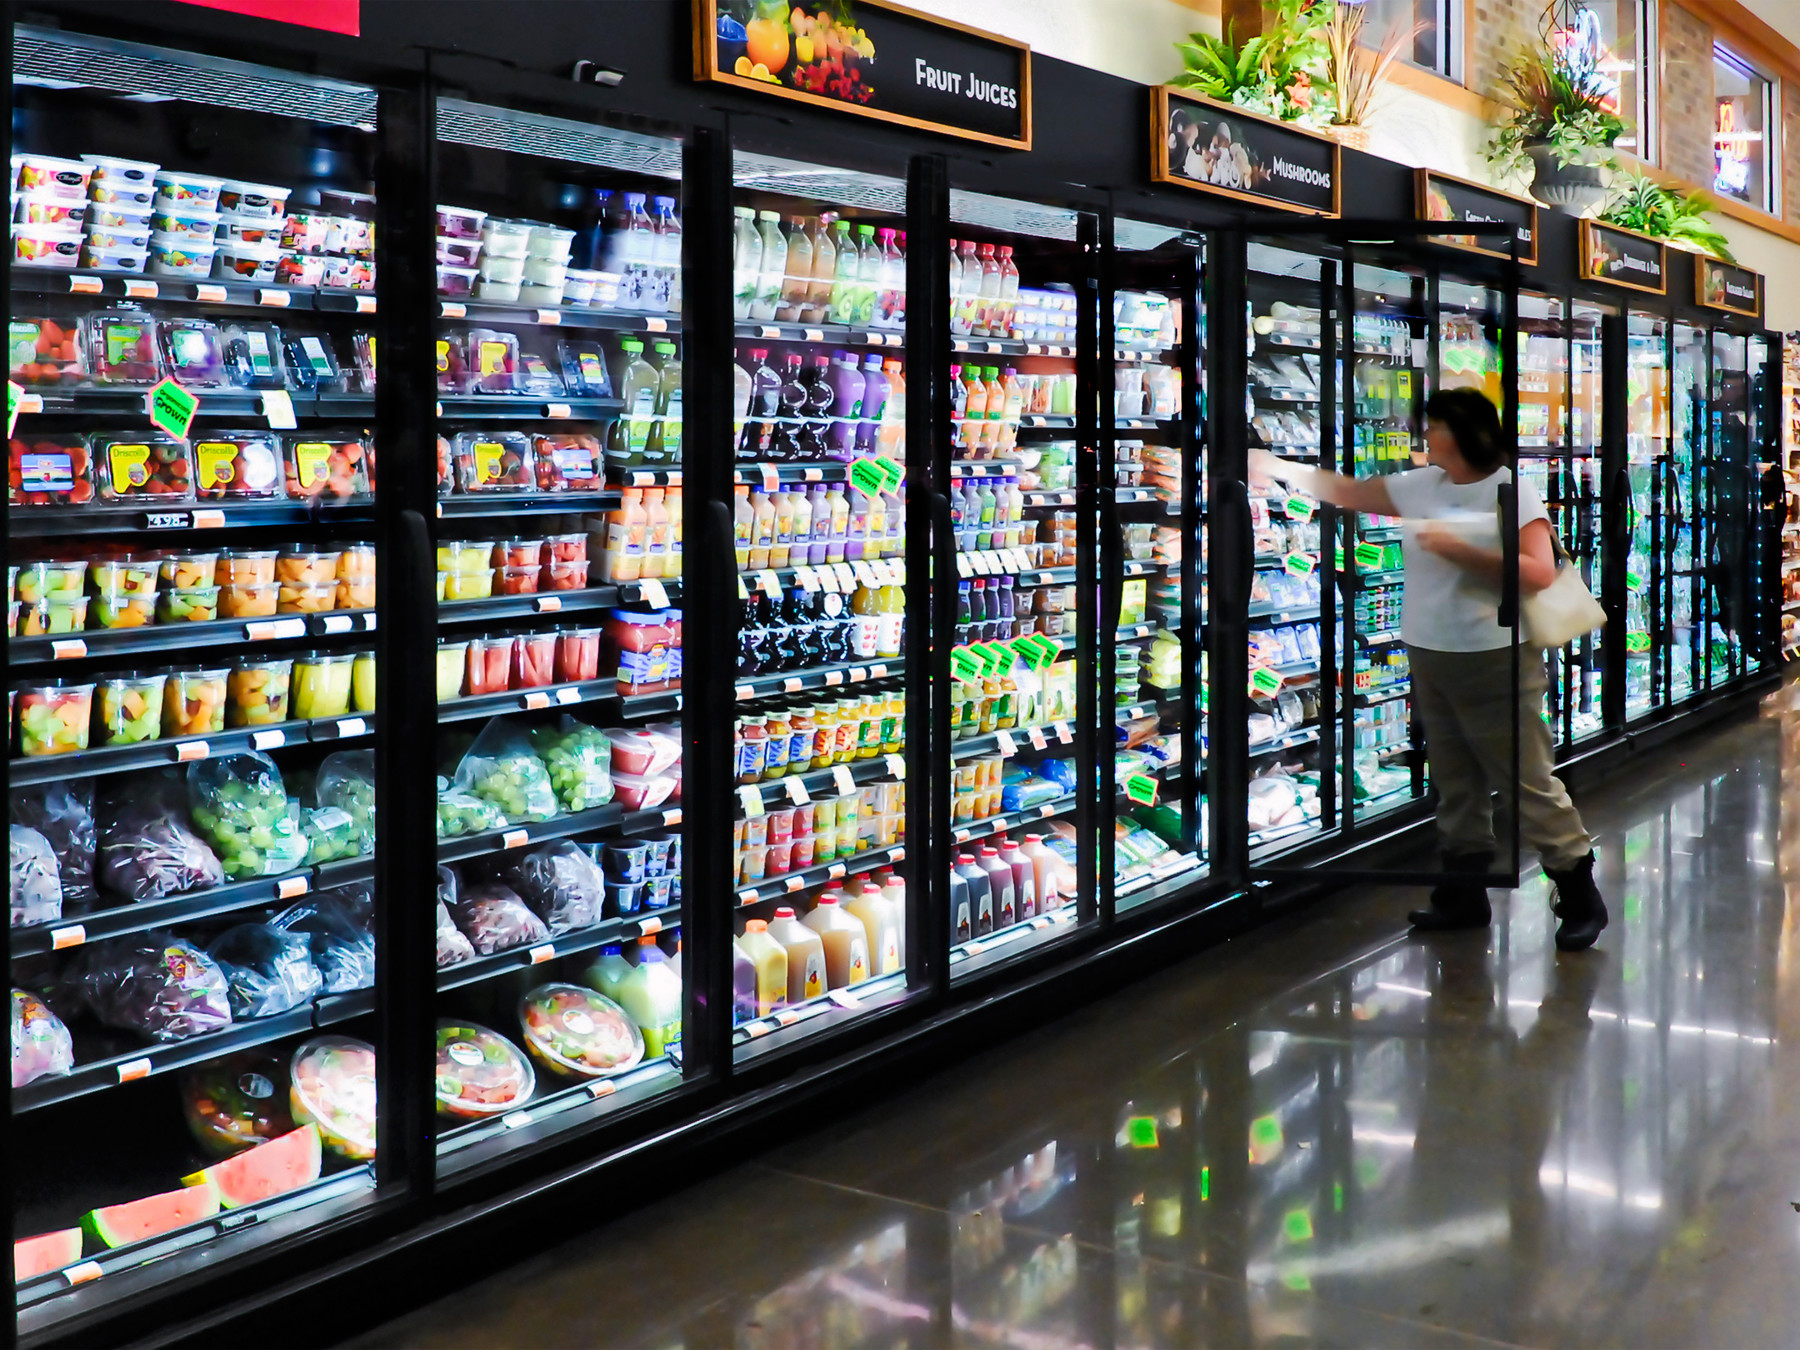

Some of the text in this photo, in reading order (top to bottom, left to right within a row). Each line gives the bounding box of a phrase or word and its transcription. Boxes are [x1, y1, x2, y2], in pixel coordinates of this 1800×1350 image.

[156, 397, 187, 426] Grown
[853, 468, 878, 490] Grown
[957, 662, 976, 677] own
